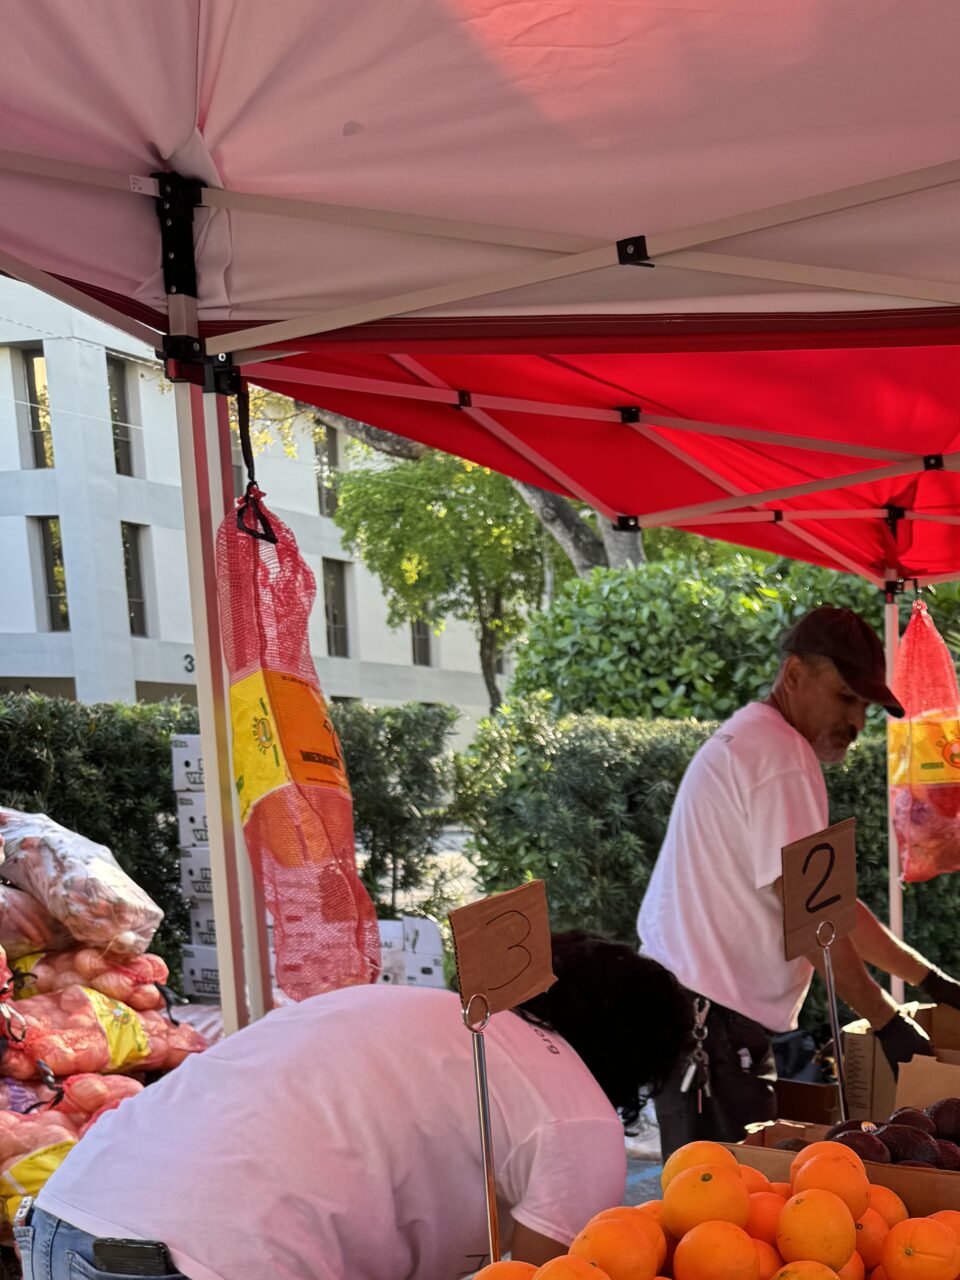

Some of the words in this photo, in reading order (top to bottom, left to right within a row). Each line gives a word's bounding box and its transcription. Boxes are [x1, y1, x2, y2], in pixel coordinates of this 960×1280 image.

[184, 653, 195, 673] 3
[801, 842, 842, 914] 2
[485, 909, 532, 991] 3
